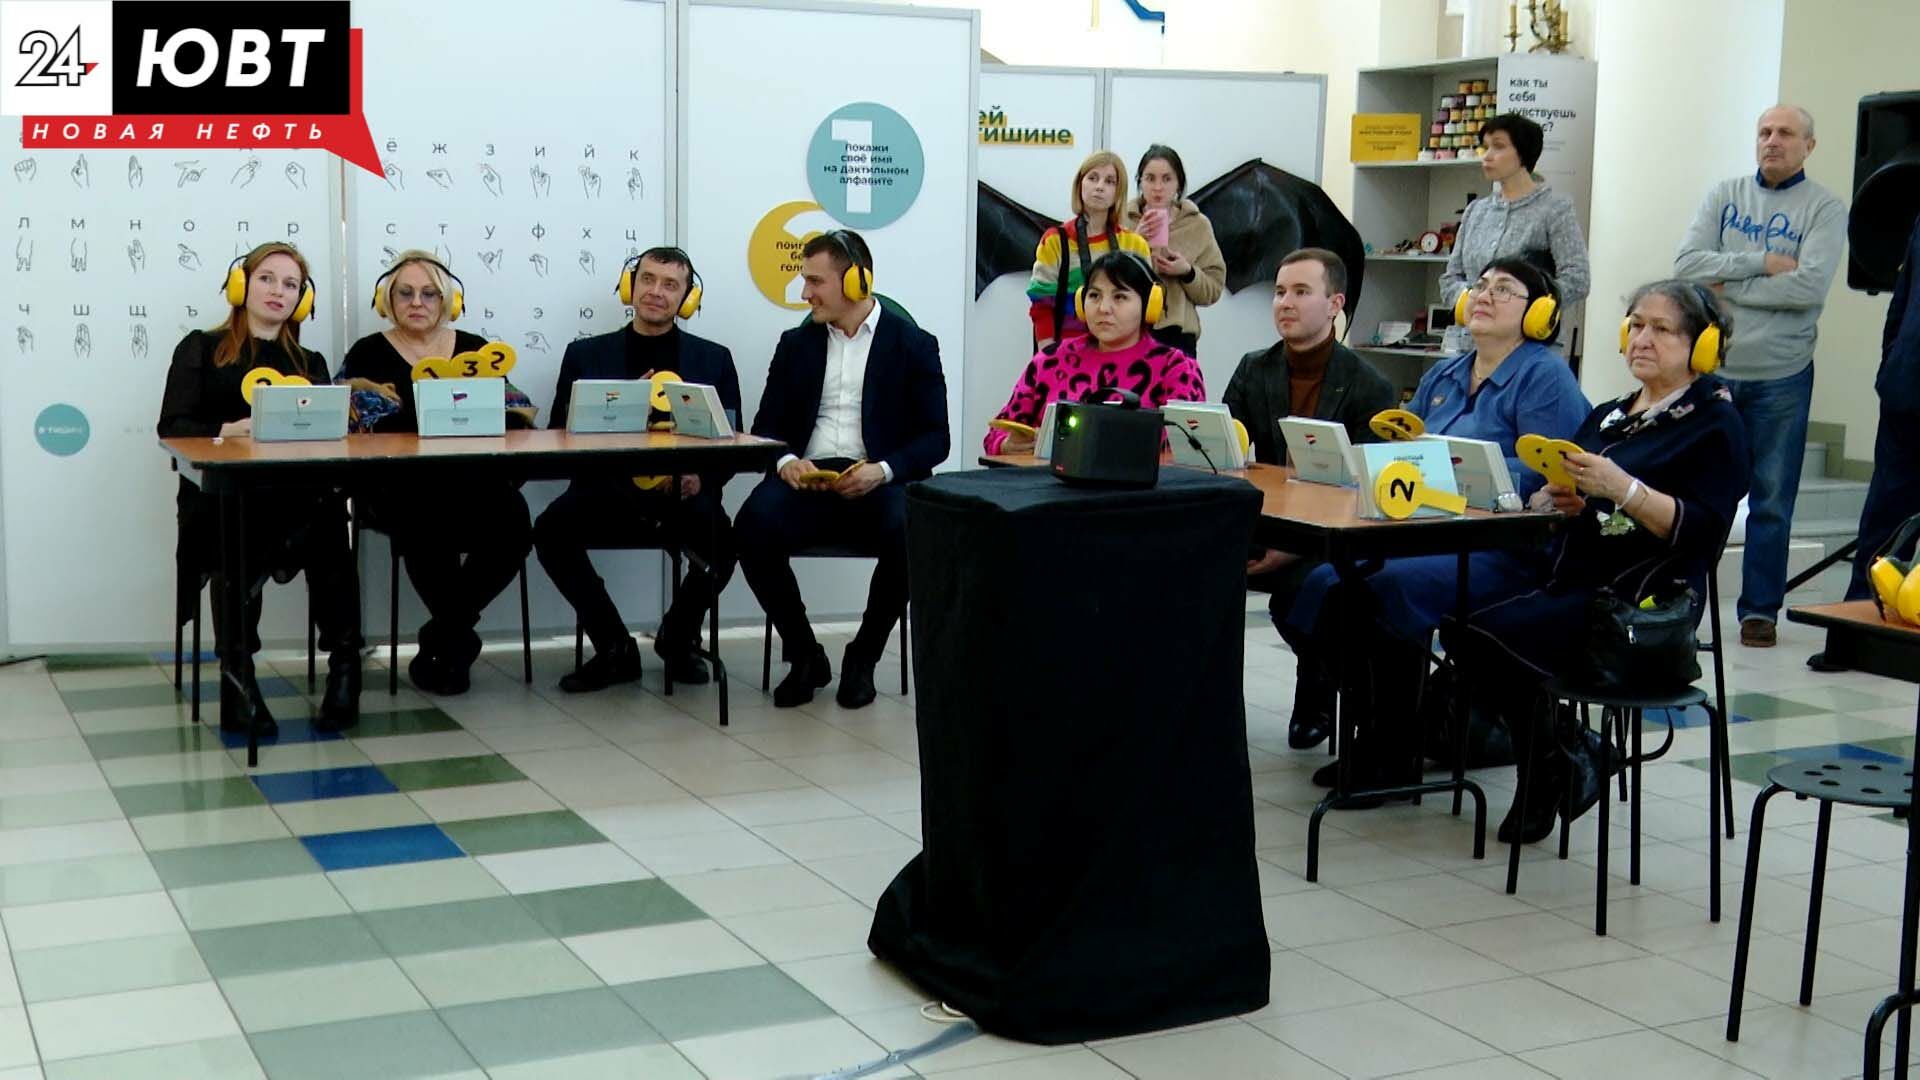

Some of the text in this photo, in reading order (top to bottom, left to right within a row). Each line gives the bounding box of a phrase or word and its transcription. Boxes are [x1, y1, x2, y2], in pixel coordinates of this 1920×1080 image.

[1510, 79, 1548, 88] как ты
[1508, 91, 1536, 102] себя
[870, 155, 893, 164] имя
[823, 164, 910, 176] на дактильном
[832, 119, 872, 214] 1
[839, 175, 893, 186] алфавите
[462, 361, 480, 377] 3
[1390, 478, 1416, 502] 2
